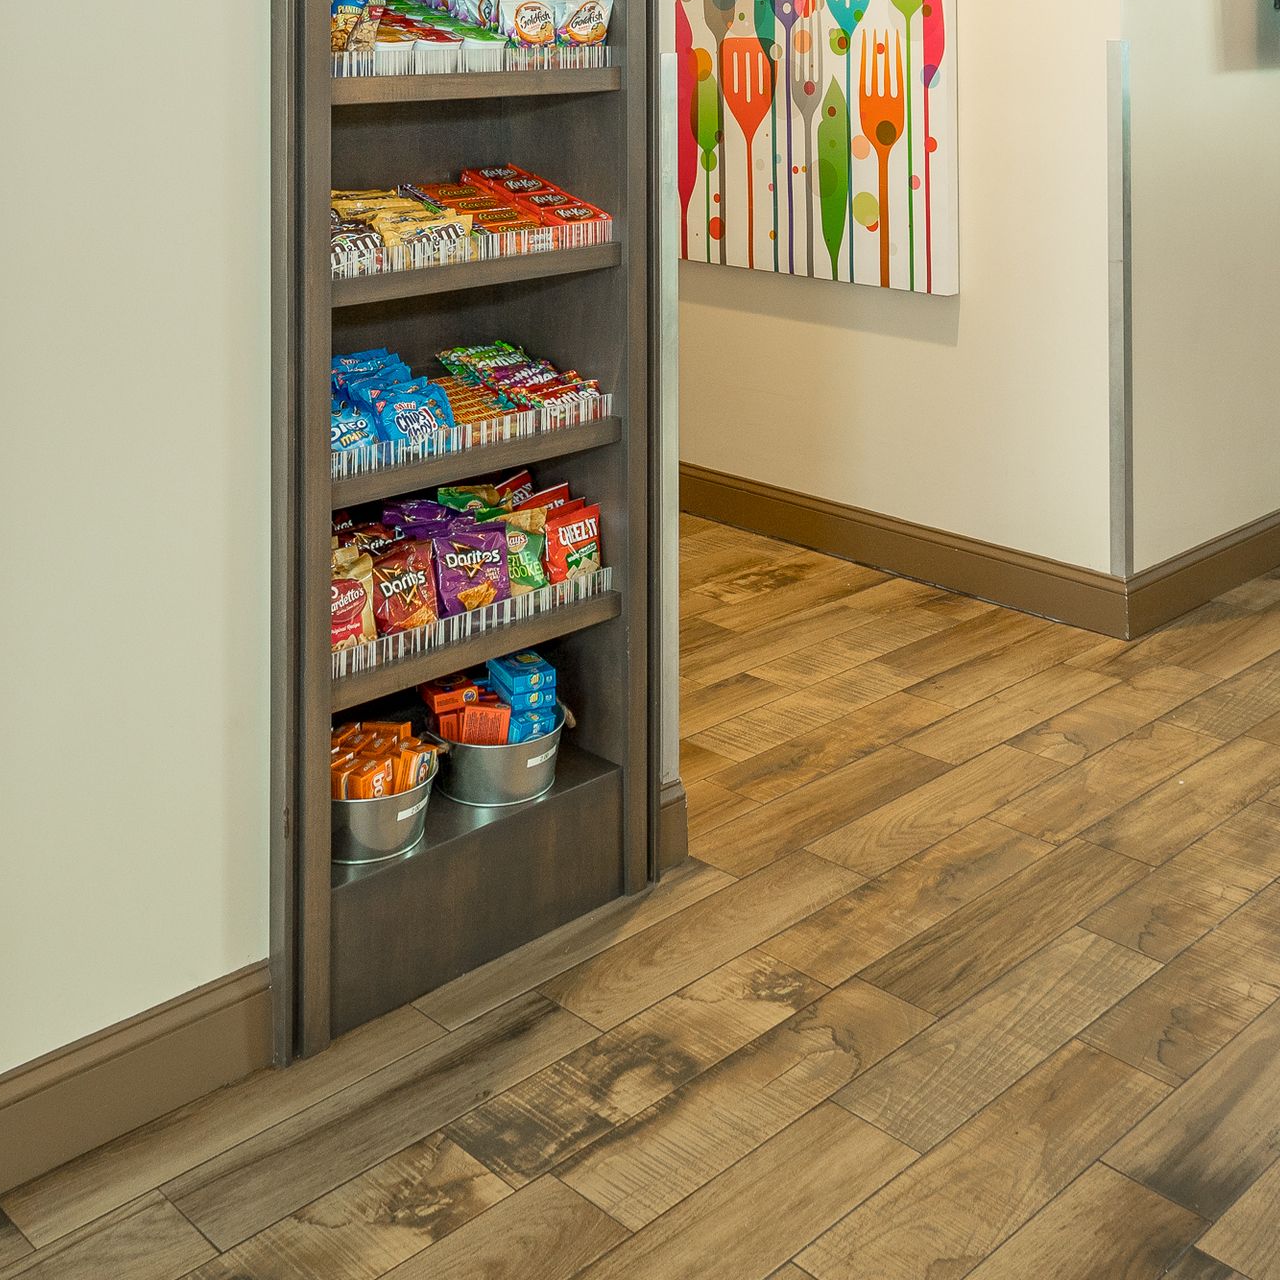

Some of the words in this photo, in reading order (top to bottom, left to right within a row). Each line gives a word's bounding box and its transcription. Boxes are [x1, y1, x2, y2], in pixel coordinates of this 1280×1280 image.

[521, 10, 551, 29] Goldfish
[571, 10, 604, 29] Goldfish
[394, 401, 417, 412] Mini
[544, 387, 600, 410] Skittles
[395, 409, 427, 432] Chips
[340, 430, 369, 448] mini
[445, 548, 501, 569] Doritos
[380, 570, 426, 598] Doritos
